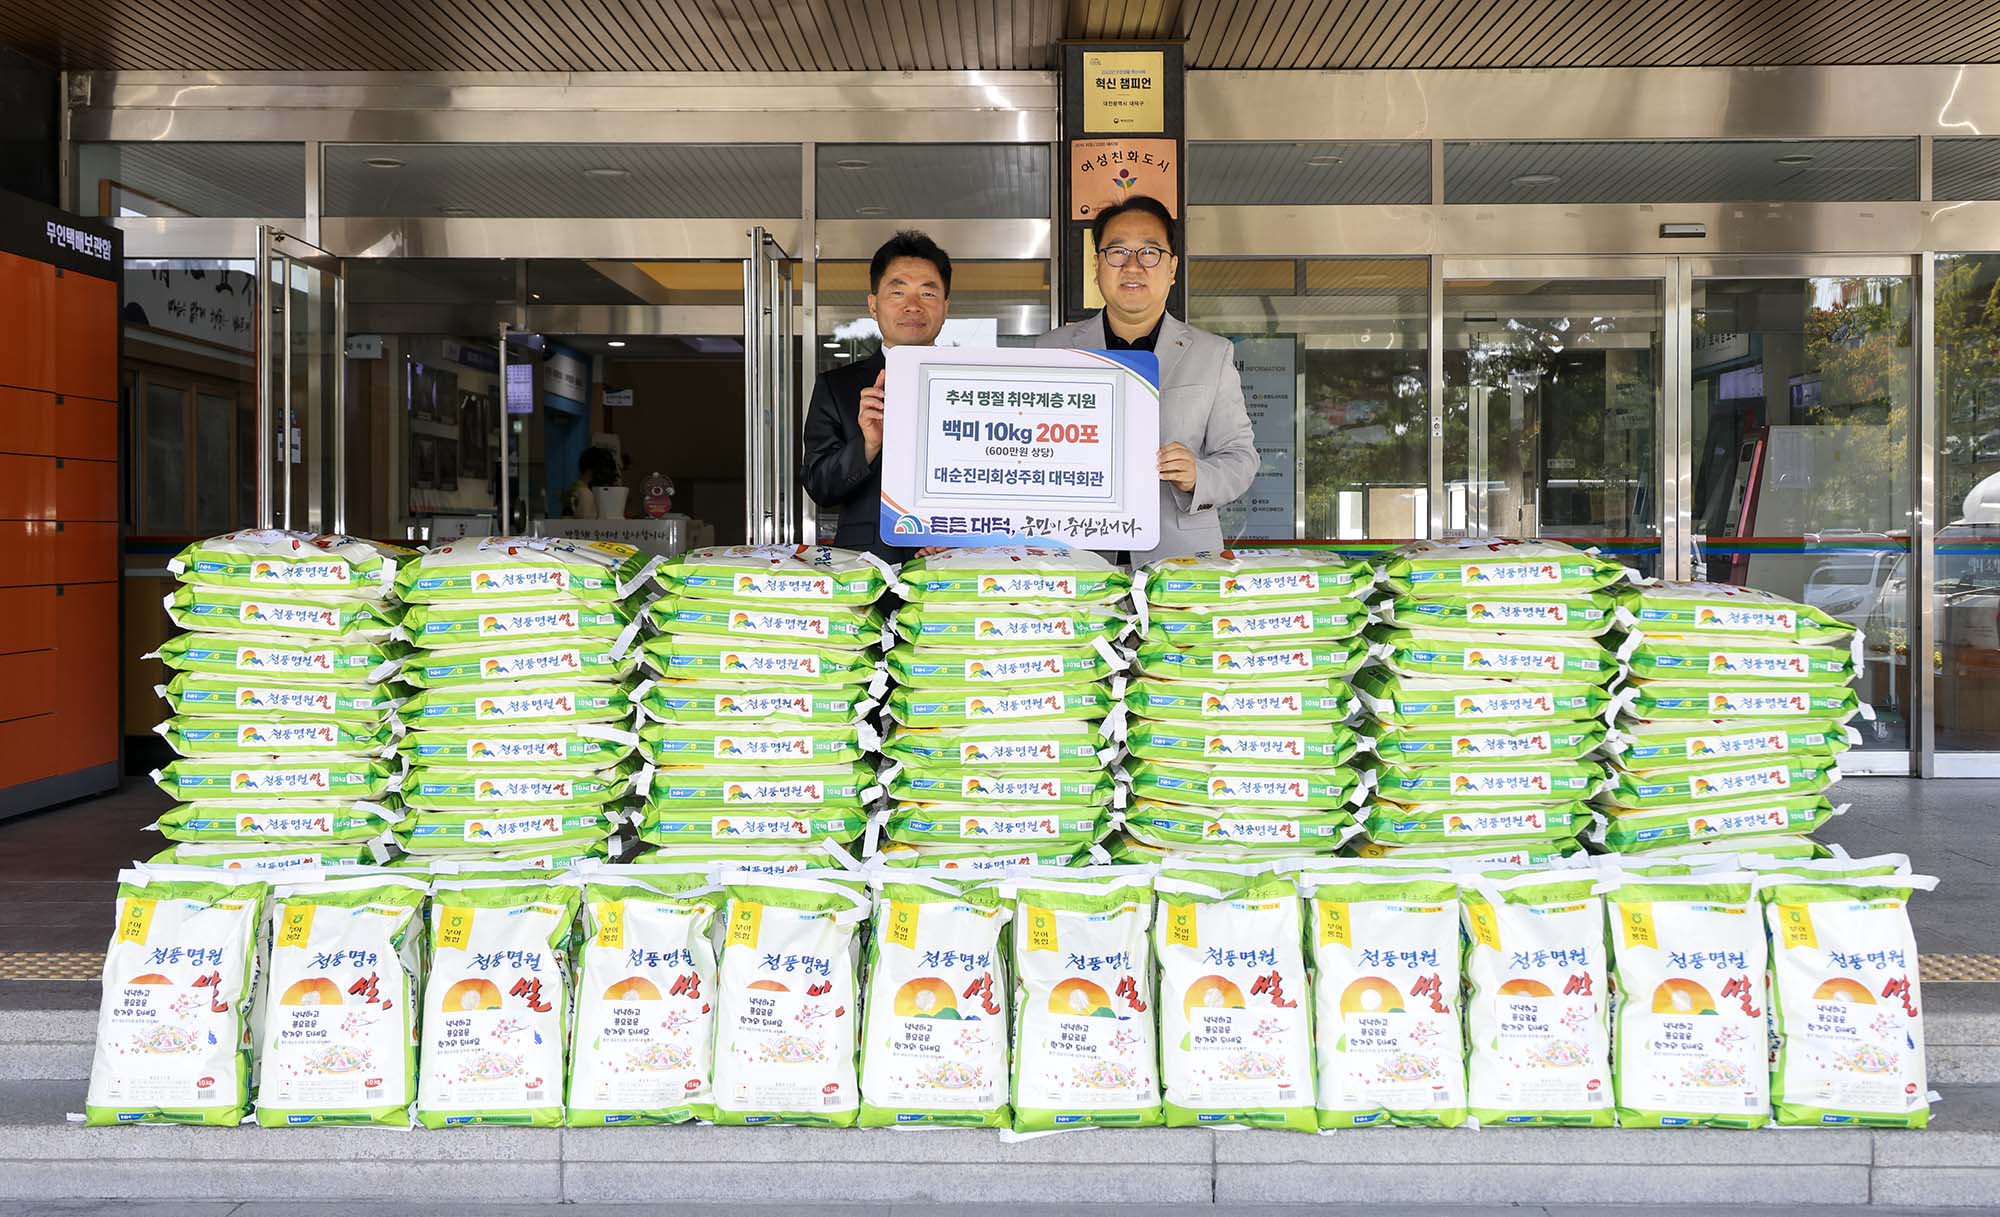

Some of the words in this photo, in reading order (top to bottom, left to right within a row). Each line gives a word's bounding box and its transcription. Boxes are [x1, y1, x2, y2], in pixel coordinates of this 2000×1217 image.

[1095, 77, 1117, 89] 혁신
[1119, 77, 1152, 89] 챔피언
[1081, 149, 1170, 173] 여성친화도시
[46, 220, 112, 261] 무인택배보관함
[946, 390, 974, 406] 추석
[977, 391, 1005, 407] 명절
[1008, 392, 1064, 408] 취약계층
[1067, 393, 1096, 409] 지원
[942, 420, 980, 442] 백미
[985, 422, 1032, 444] 10kg
[1036, 423, 1099, 444] 200포
[985, 447, 1028, 458] (600만원
[1031, 447, 1054, 458] 상당)
[934, 467, 1045, 486] 대순진리회성주회
[1049, 470, 1104, 487] 대덕회관
[145, 947, 224, 966] 청풍명월
[467, 950, 542, 972] 청풍명월
[626, 948, 695, 968] 청풍명월
[759, 953, 831, 977] 청풍명월
[918, 950, 990, 972] 청풍명월
[1202, 946, 1279, 968] 청풍명월
[1358, 949, 1440, 968] 청풍명월
[1509, 947, 1589, 970] 청풍명월
[1666, 951, 1748, 970] 청풍명월
[1828, 948, 1906, 971] 청풍명월
[510, 976, 552, 1012] 쌀
[963, 972, 1000, 1015] 쌀
[1116, 976, 1147, 1012] 쌀
[1410, 974, 1449, 1013] 쌀
[1721, 975, 1760, 1018] 쌀
[1882, 975, 1917, 1017] 쌀
